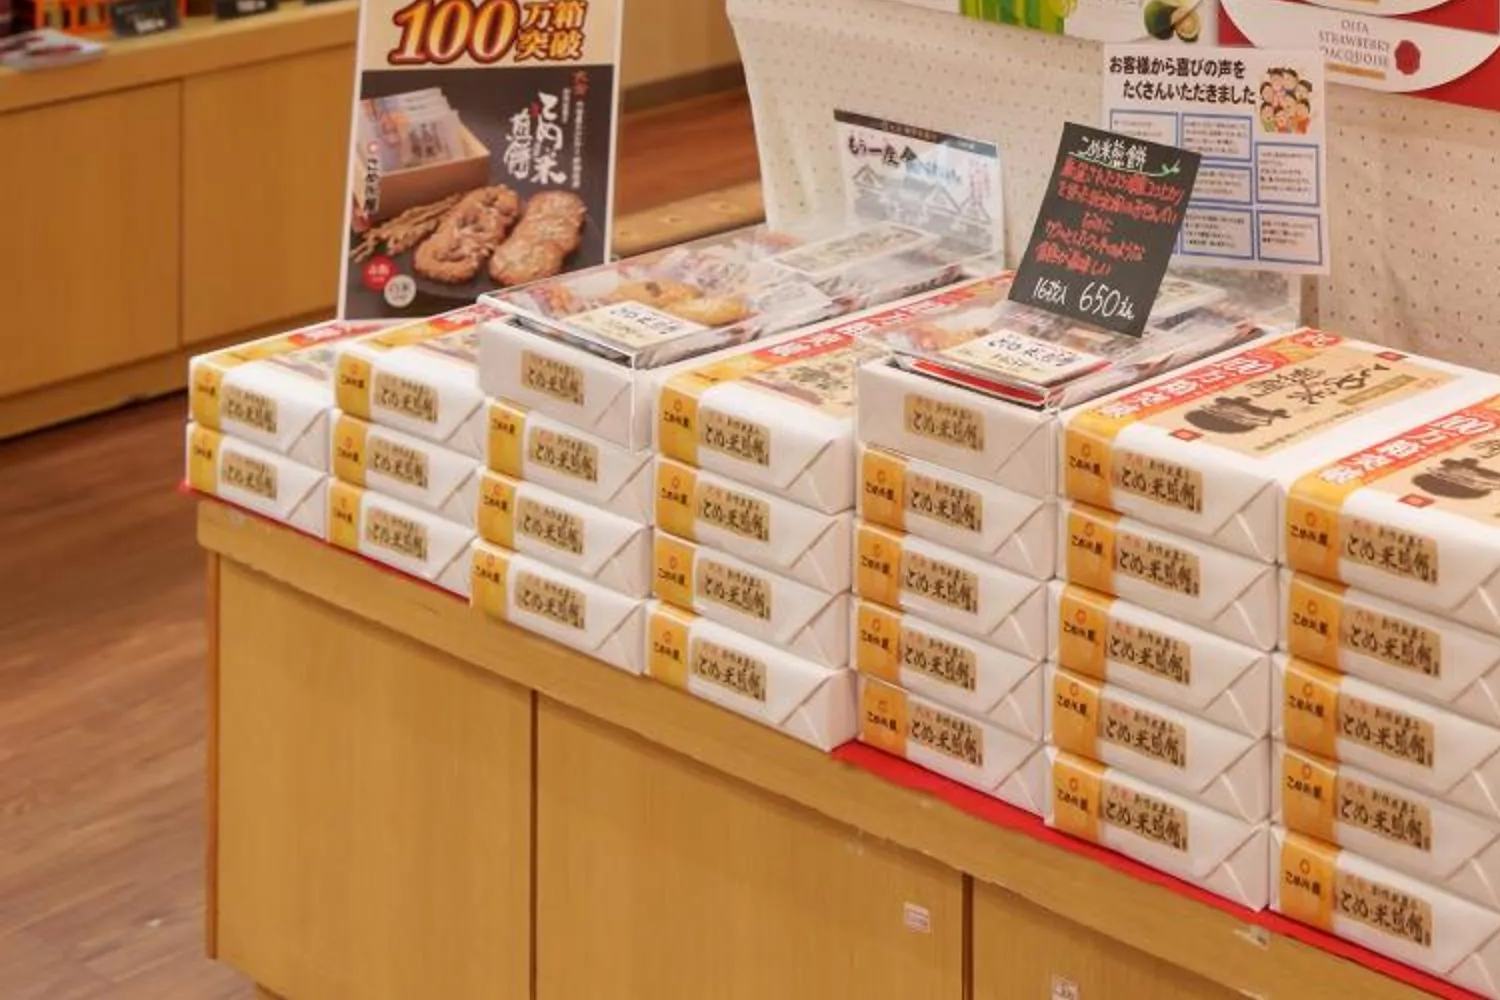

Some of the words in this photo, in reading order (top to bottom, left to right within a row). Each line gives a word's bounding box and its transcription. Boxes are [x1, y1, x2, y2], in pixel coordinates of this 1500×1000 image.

[1109, 55, 1246, 79] お客様から喜びの声を
[1122, 80, 1255, 106] たくさんいただきました
